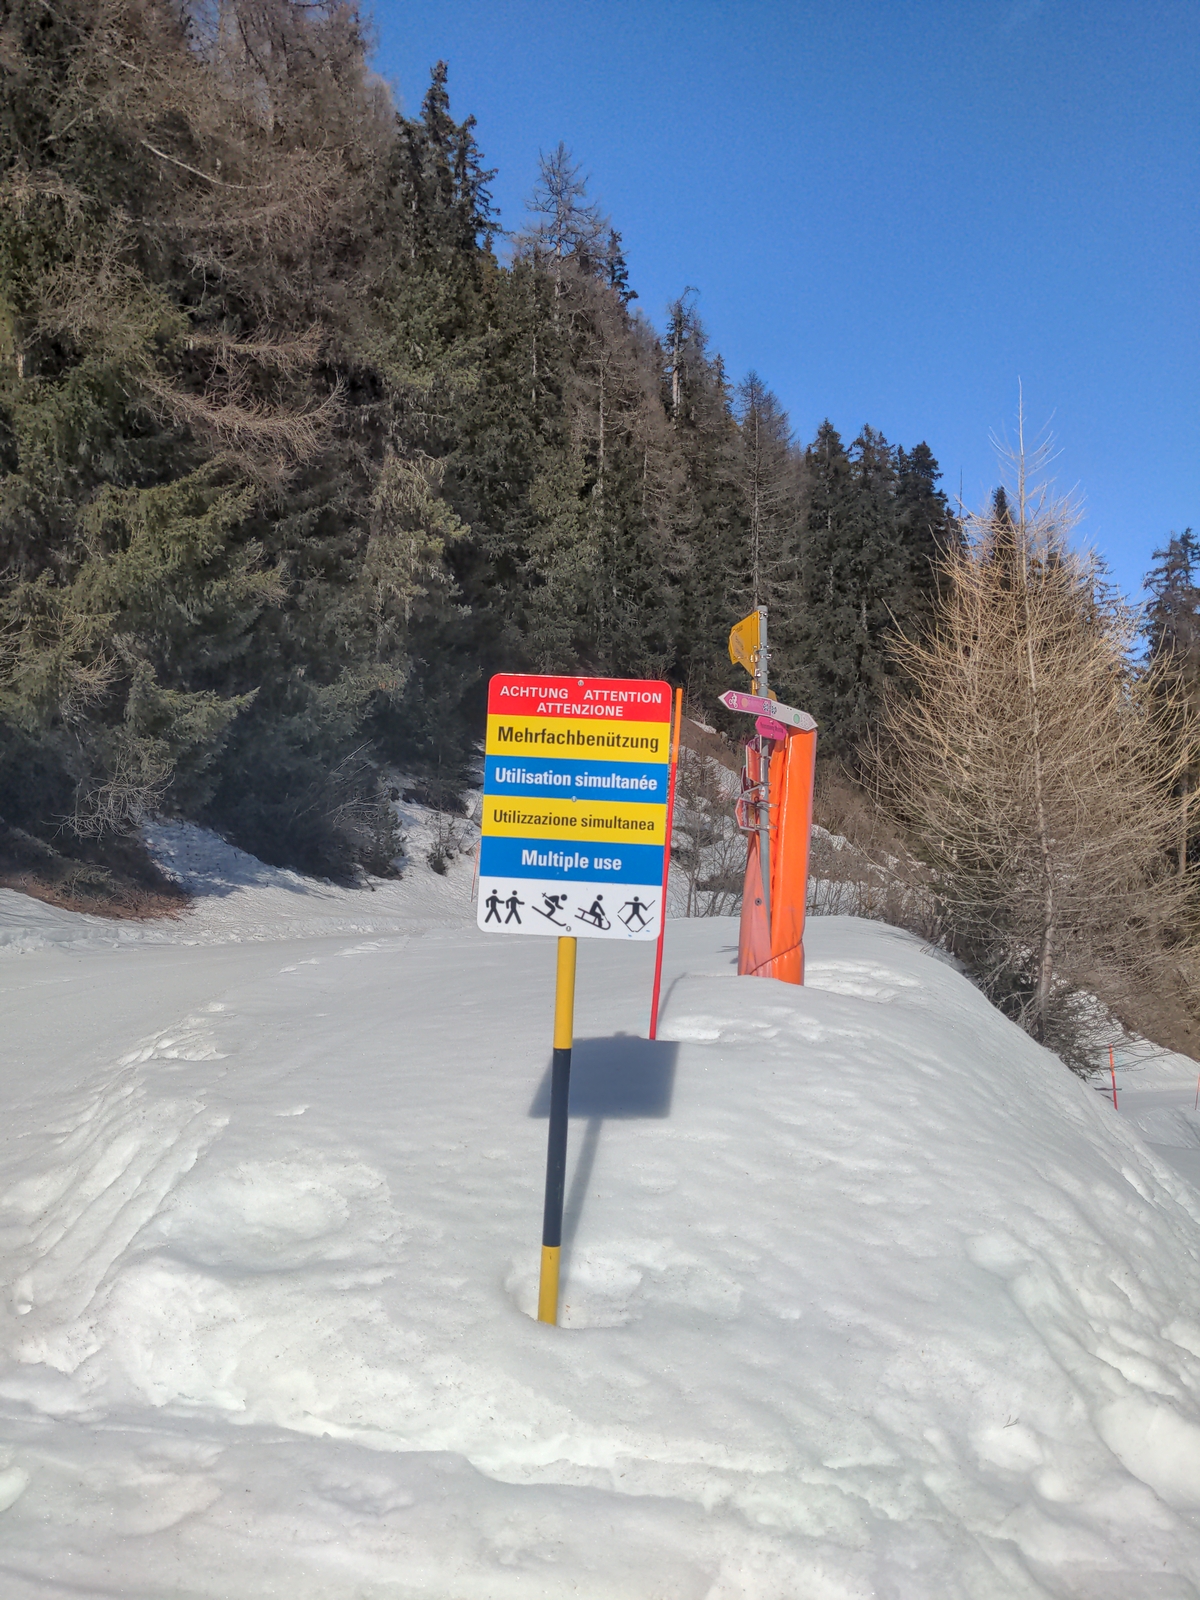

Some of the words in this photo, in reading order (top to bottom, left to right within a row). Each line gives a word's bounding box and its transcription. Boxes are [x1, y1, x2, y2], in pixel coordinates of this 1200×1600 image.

[500, 685, 569, 699] ACHTUNG
[584, 689, 662, 703] ATTENTION
[537, 702, 624, 717] ATTENZIONE
[497, 726, 659, 753] Mehrfachbenützung
[495, 767, 571, 786] Utilisation
[575, 772, 658, 791] simultanée
[493, 809, 577, 827] Utilizzazione
[581, 814, 655, 831] simultanea
[521, 849, 589, 872] Multiple
[593, 858, 622, 871] use
